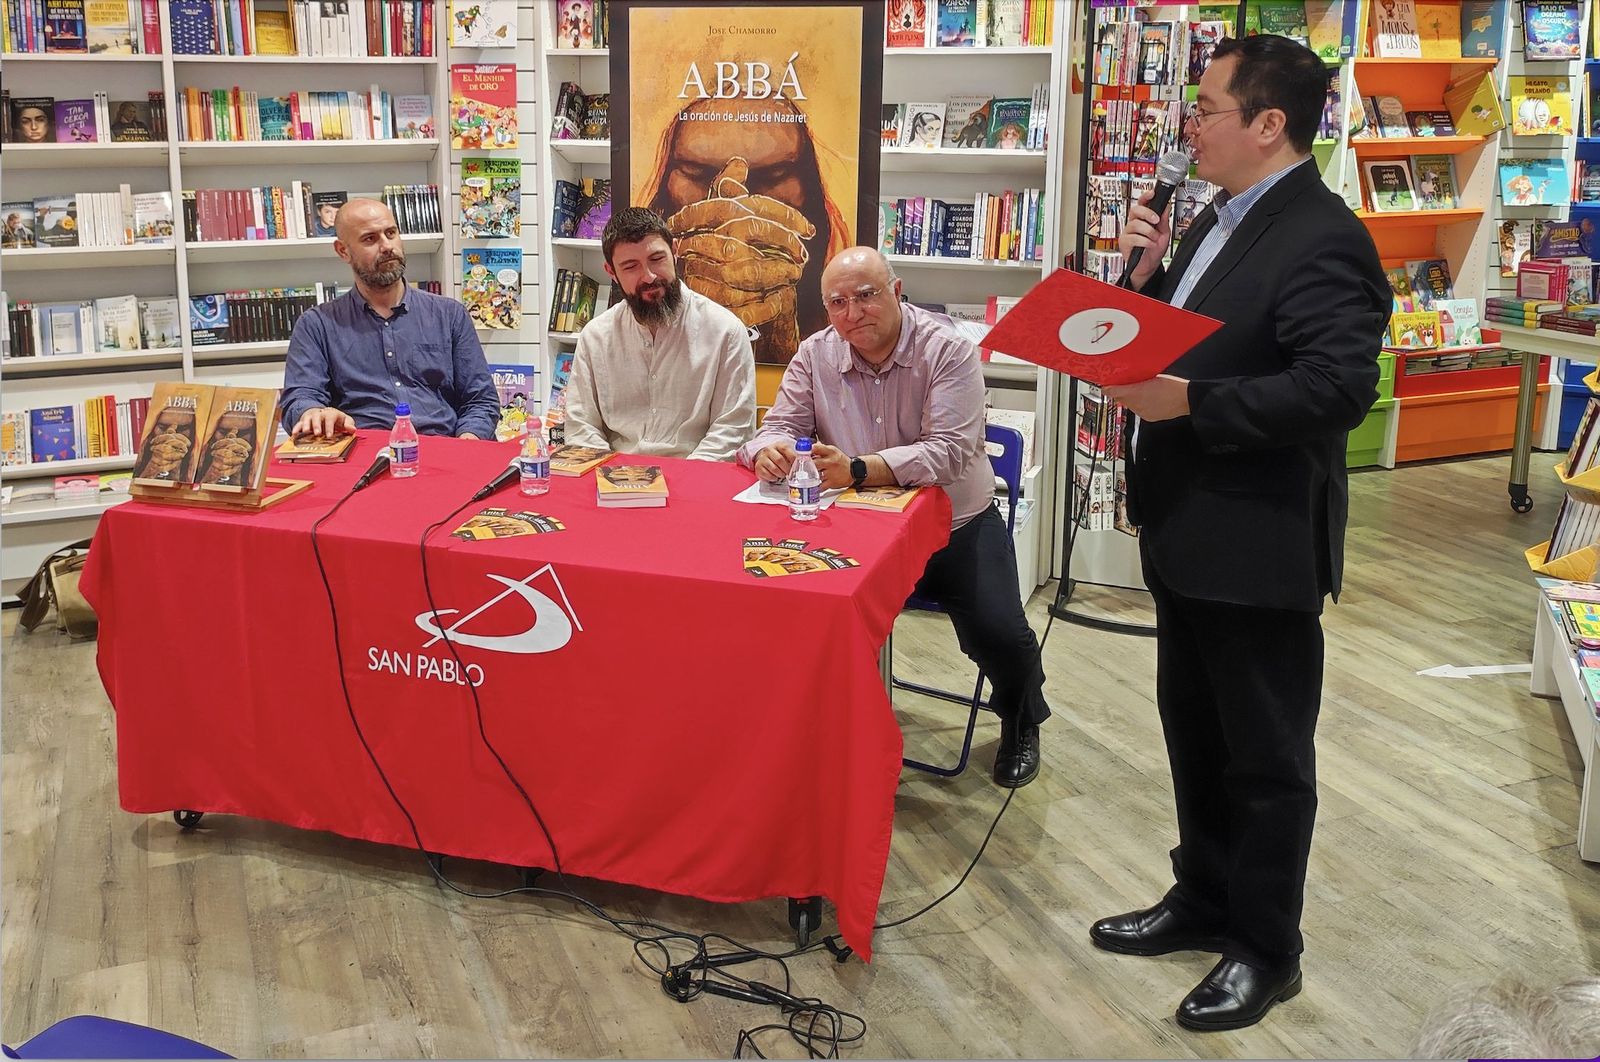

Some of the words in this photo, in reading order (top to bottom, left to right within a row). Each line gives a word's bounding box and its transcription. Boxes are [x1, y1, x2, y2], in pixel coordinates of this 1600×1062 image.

[676, 51, 808, 100] ABBÁ
[480, 82, 499, 90] ORO
[66, 106, 84, 115] TAN
[679, 110, 688, 120] La
[690, 110, 720, 121] oración
[723, 111, 734, 121] de
[735, 111, 758, 122] Jesús
[760, 112, 771, 122] de
[774, 112, 807, 123] Nazaret
[164, 394, 199, 409] ABBÁ
[224, 399, 259, 413] ABBÁ
[368, 647, 411, 676] SAN
[417, 654, 485, 687] PABLO
